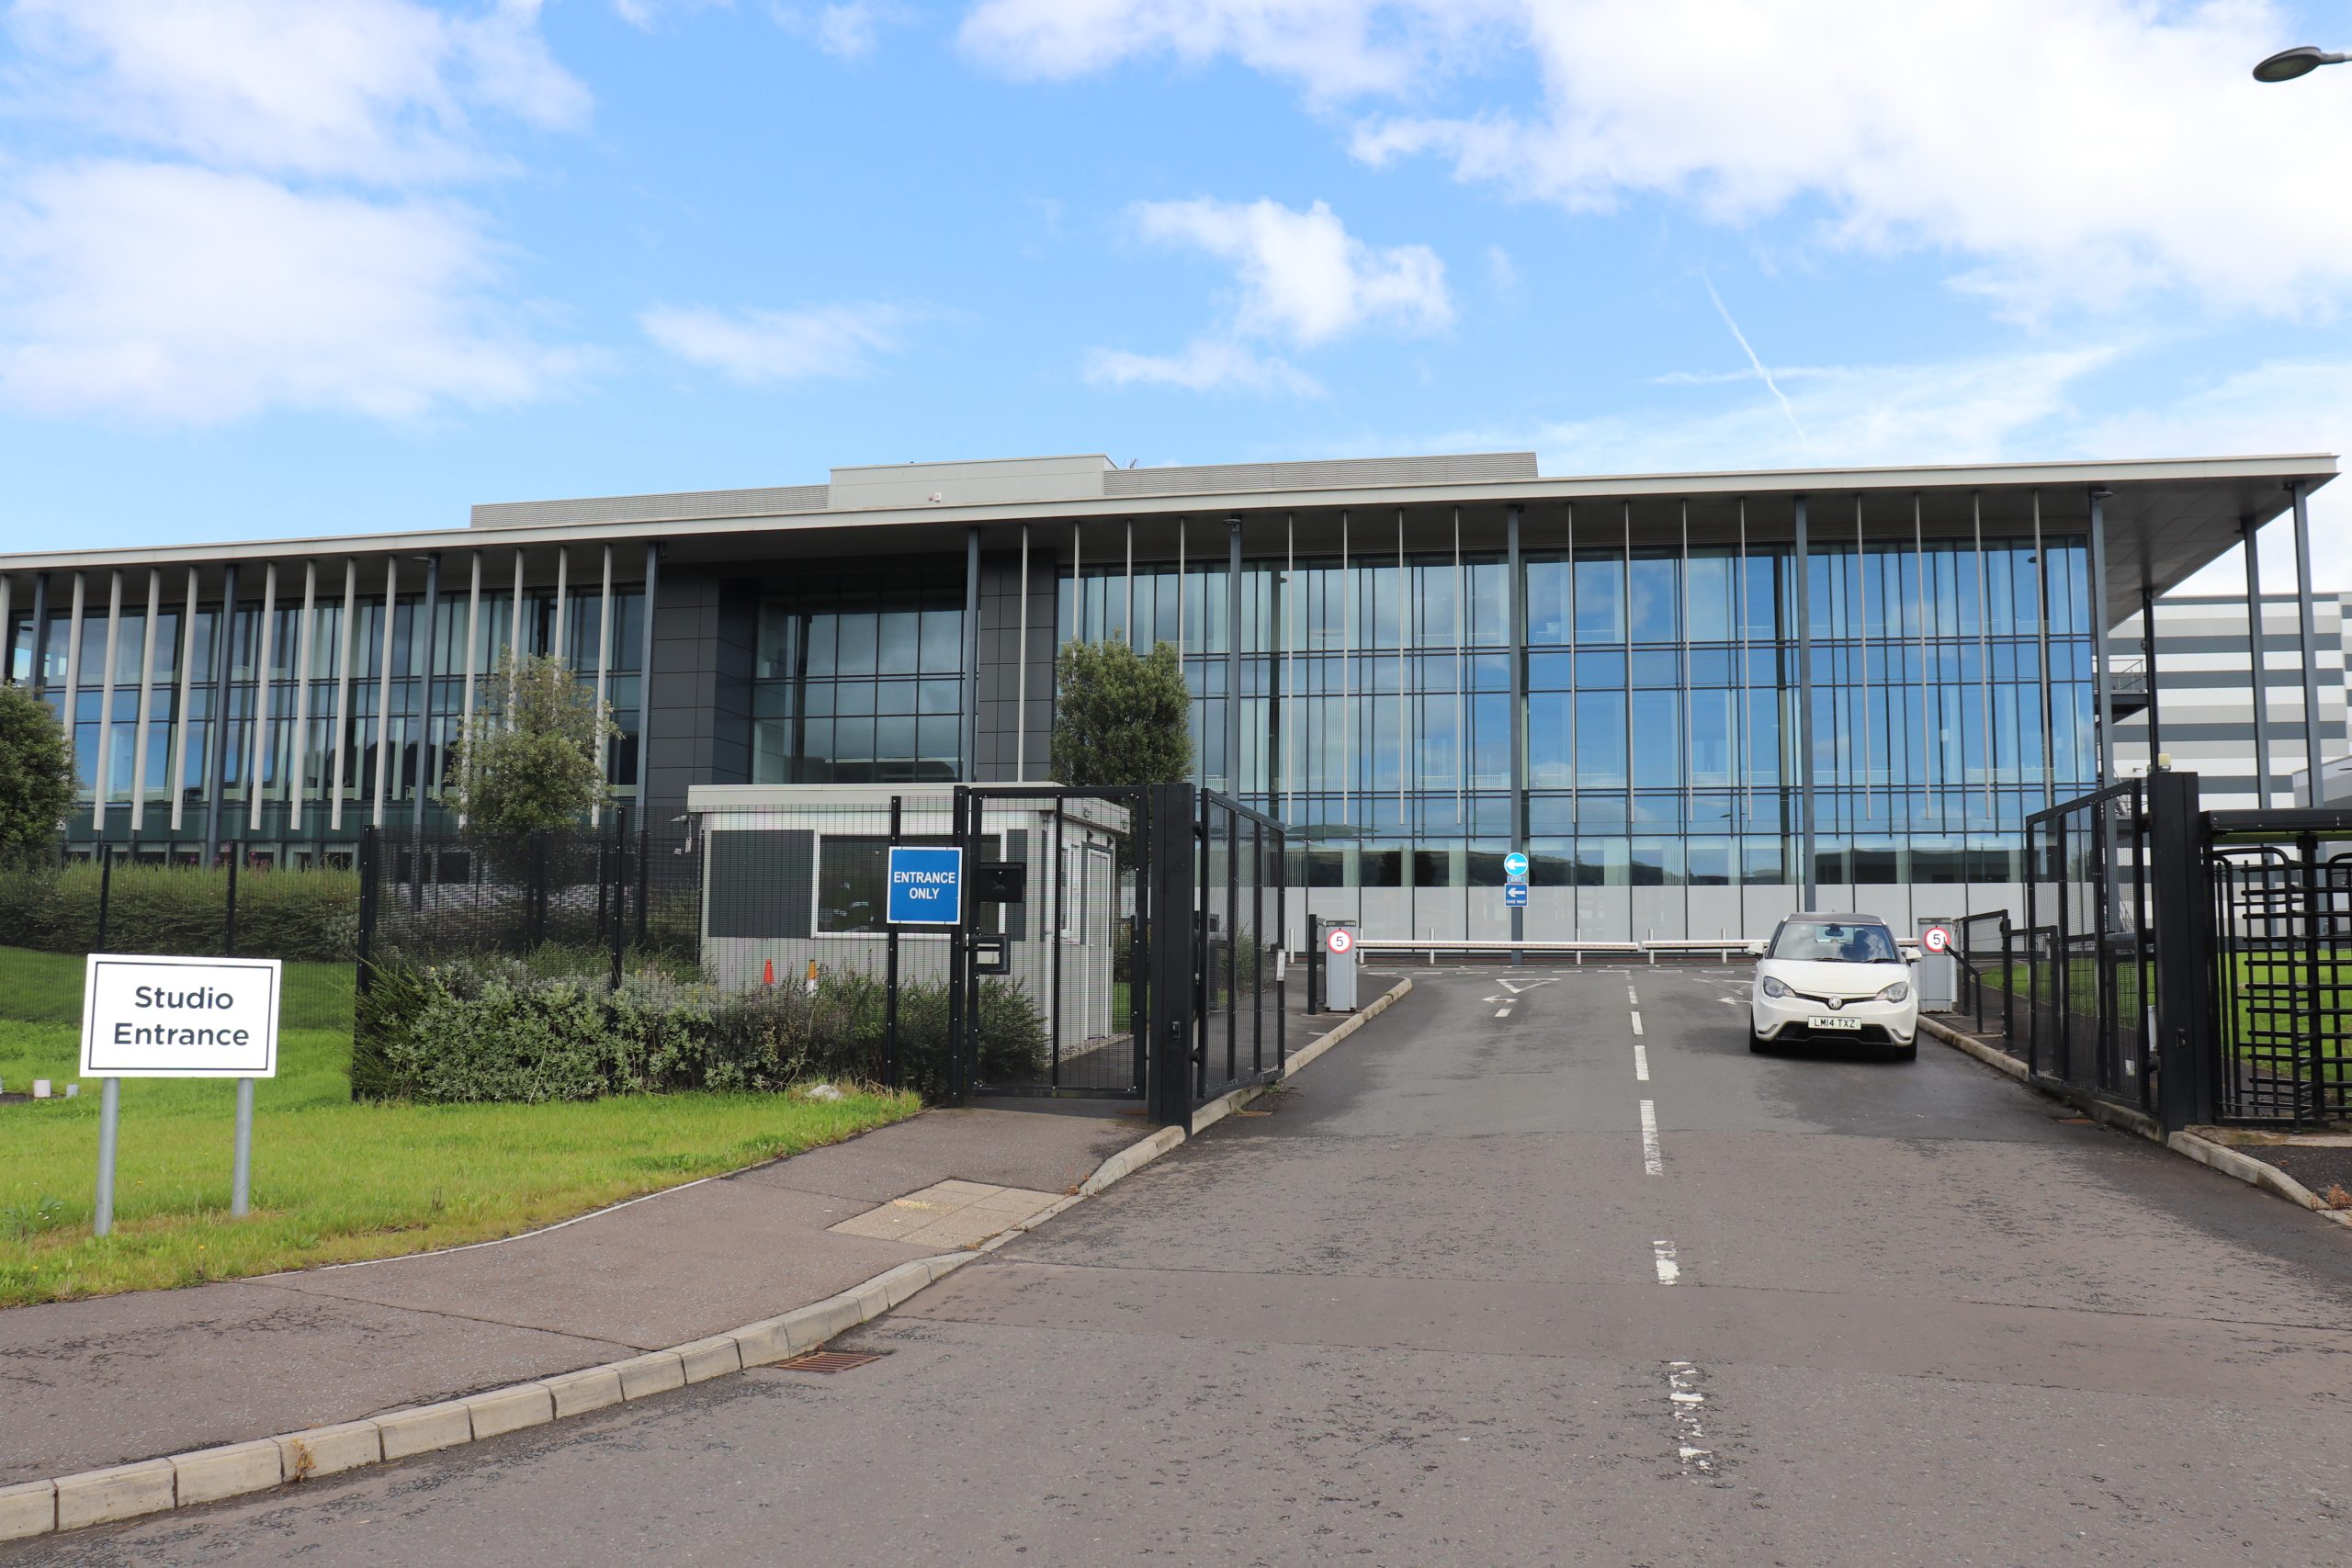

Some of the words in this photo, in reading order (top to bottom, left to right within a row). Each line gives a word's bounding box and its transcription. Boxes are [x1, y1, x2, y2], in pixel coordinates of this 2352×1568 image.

[893, 872, 956, 884] ENTRANCE
[909, 887, 941, 899] ONLY
[1336, 936, 1344, 947] 5
[1933, 933, 1941, 945] 5
[134, 986, 234, 1010] Studio
[1814, 1018, 1835, 1027] LM14
[1838, 1019, 1856, 1028] TXZ
[114, 1022, 249, 1046] Entrance
